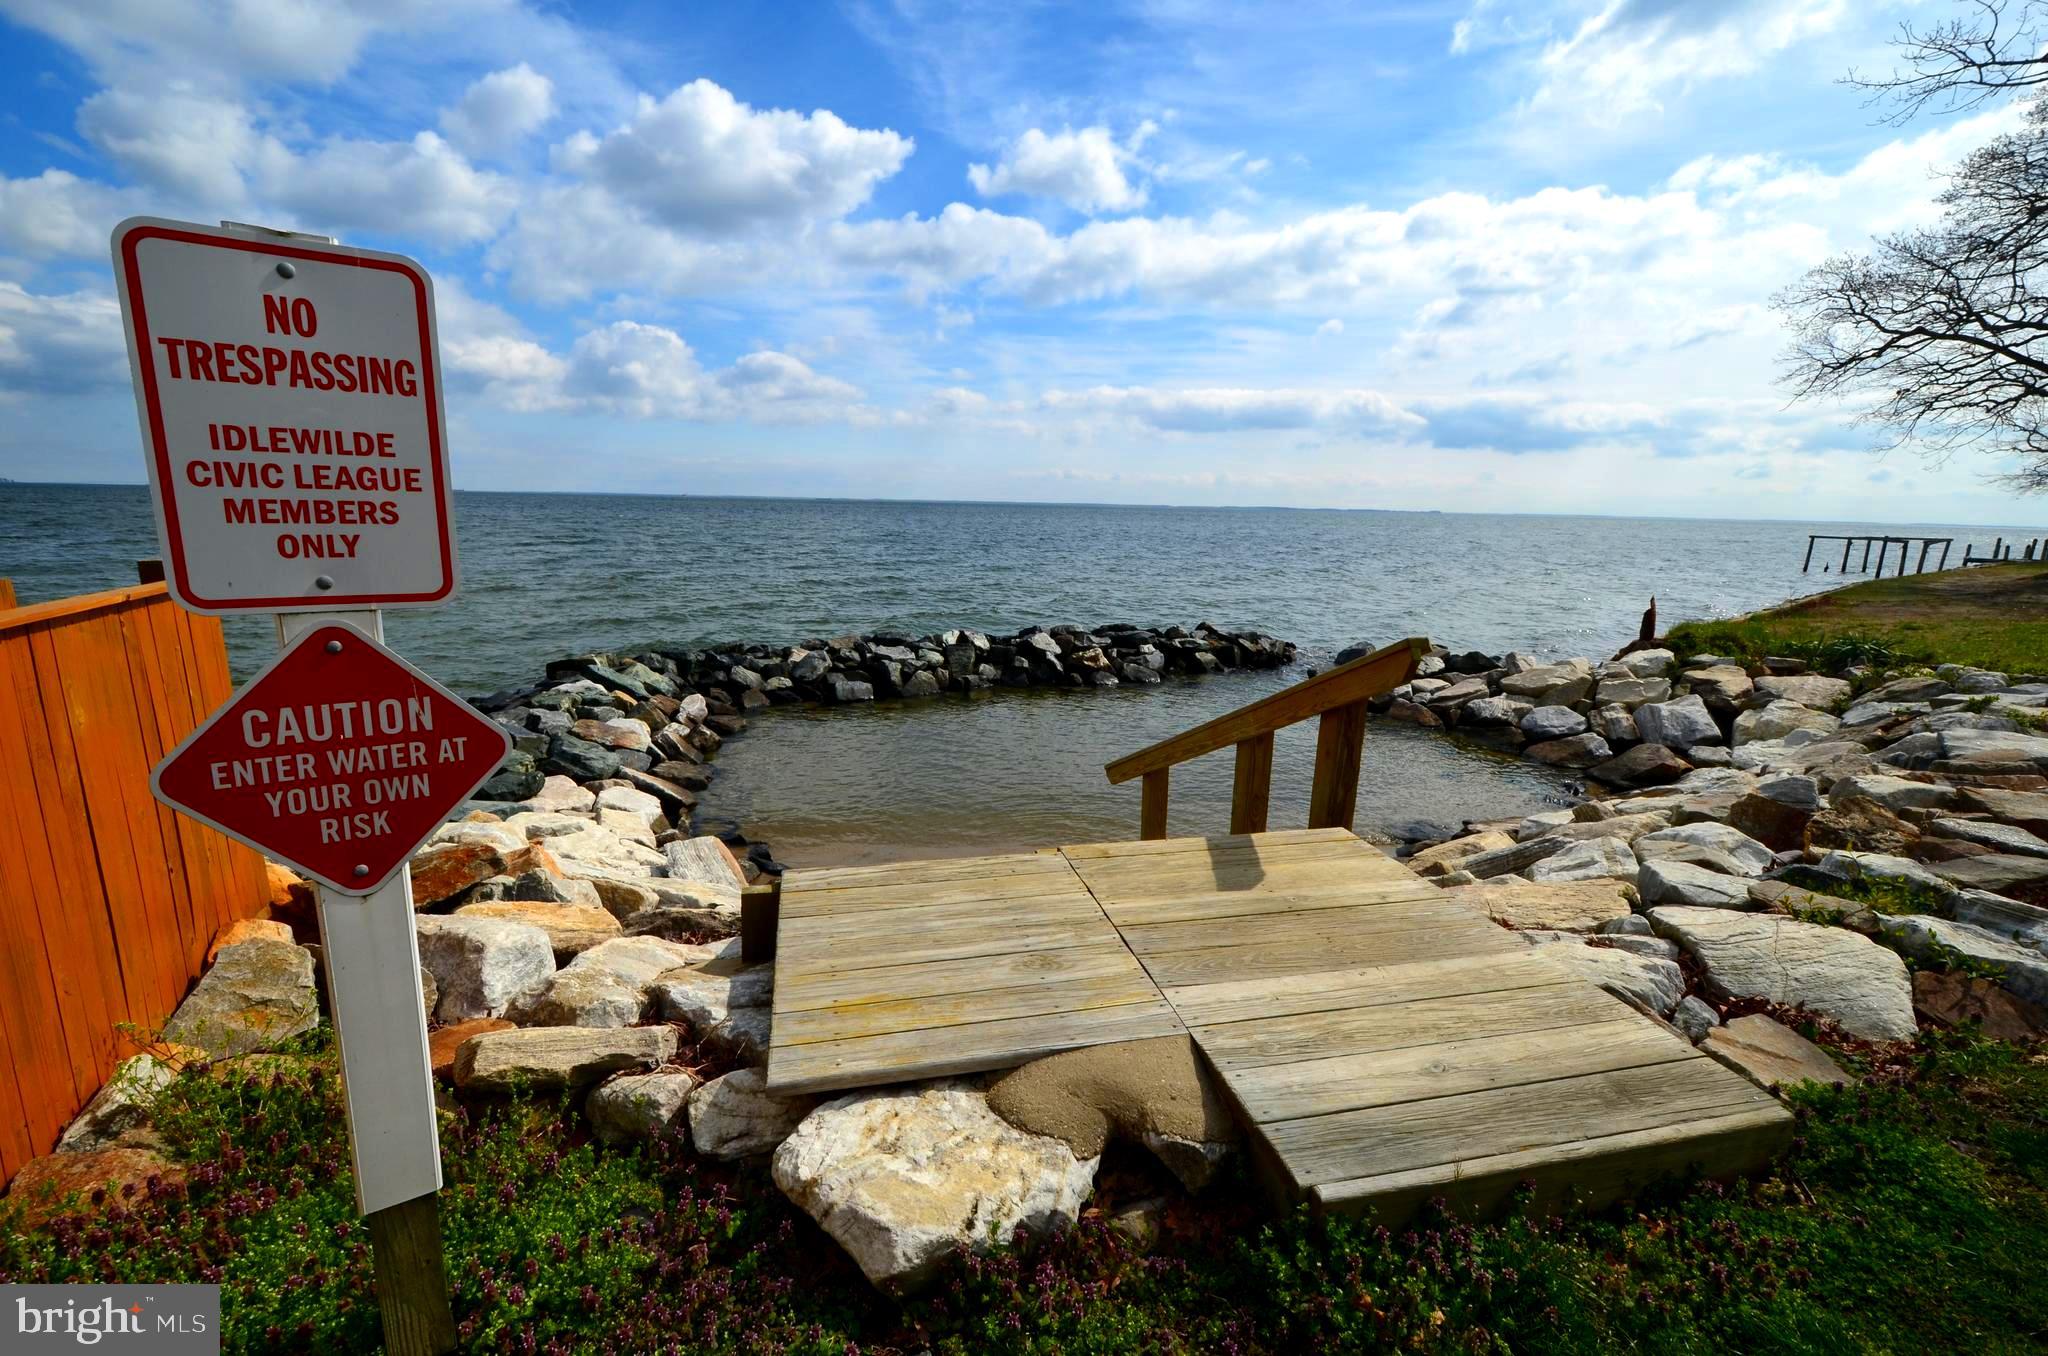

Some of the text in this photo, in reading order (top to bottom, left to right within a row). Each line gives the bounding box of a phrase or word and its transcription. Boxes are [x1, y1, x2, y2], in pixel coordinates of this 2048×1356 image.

[263, 294, 317, 338] NO
[158, 337, 418, 398] TRESPASSING
[208, 423, 396, 458] IDLEWILDE
[186, 460, 423, 492] CIVIC LEAGUE
[223, 498, 400, 526] MEMBERS
[276, 533, 361, 559] ONLY
[241, 695, 434, 749] CAUTION
[210, 736, 468, 790] ENTER WATER AT
[264, 773, 431, 818] YOUR OWN
[320, 810, 393, 844] RISK
